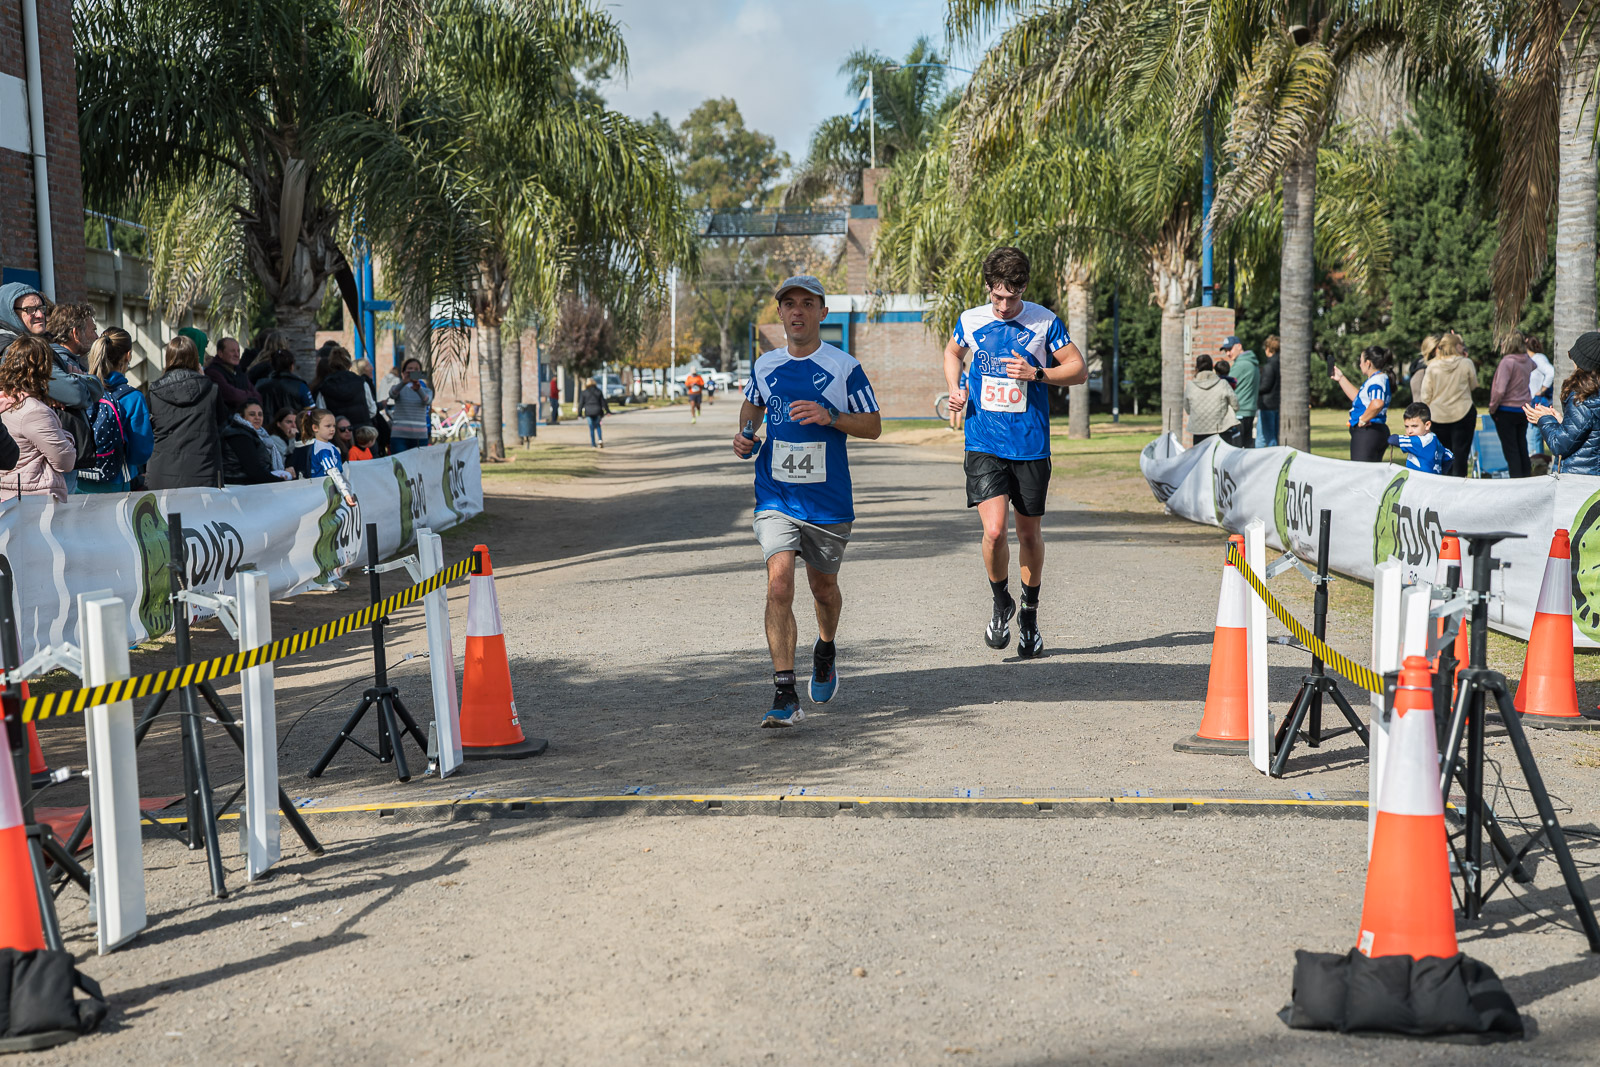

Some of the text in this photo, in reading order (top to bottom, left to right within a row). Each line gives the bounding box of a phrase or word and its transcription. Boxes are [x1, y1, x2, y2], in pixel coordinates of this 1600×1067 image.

[977, 350, 991, 375] 3
[984, 385, 1023, 404] 510
[769, 395, 784, 426] 3
[781, 453, 814, 474] 44
